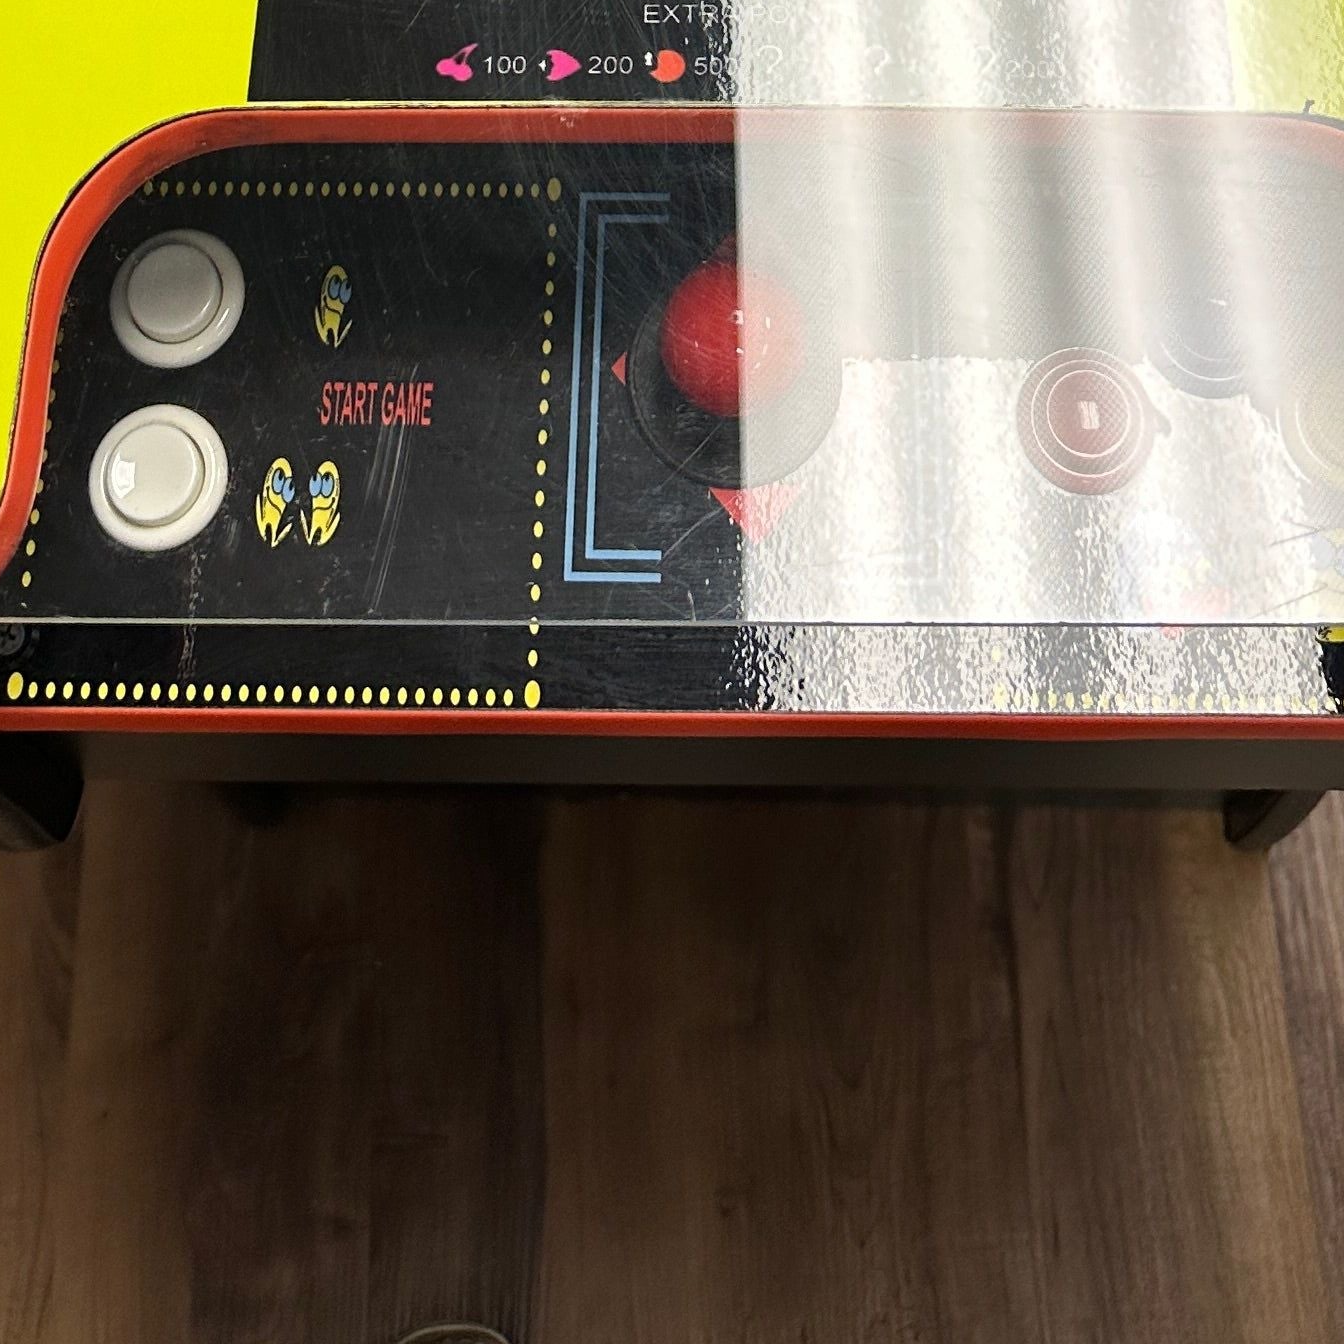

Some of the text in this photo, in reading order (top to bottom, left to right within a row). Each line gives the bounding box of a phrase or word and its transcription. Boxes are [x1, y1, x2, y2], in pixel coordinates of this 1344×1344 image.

[484, 55, 527, 74] 100
[588, 55, 634, 74] 200
[320, 381, 434, 426] START GAME
